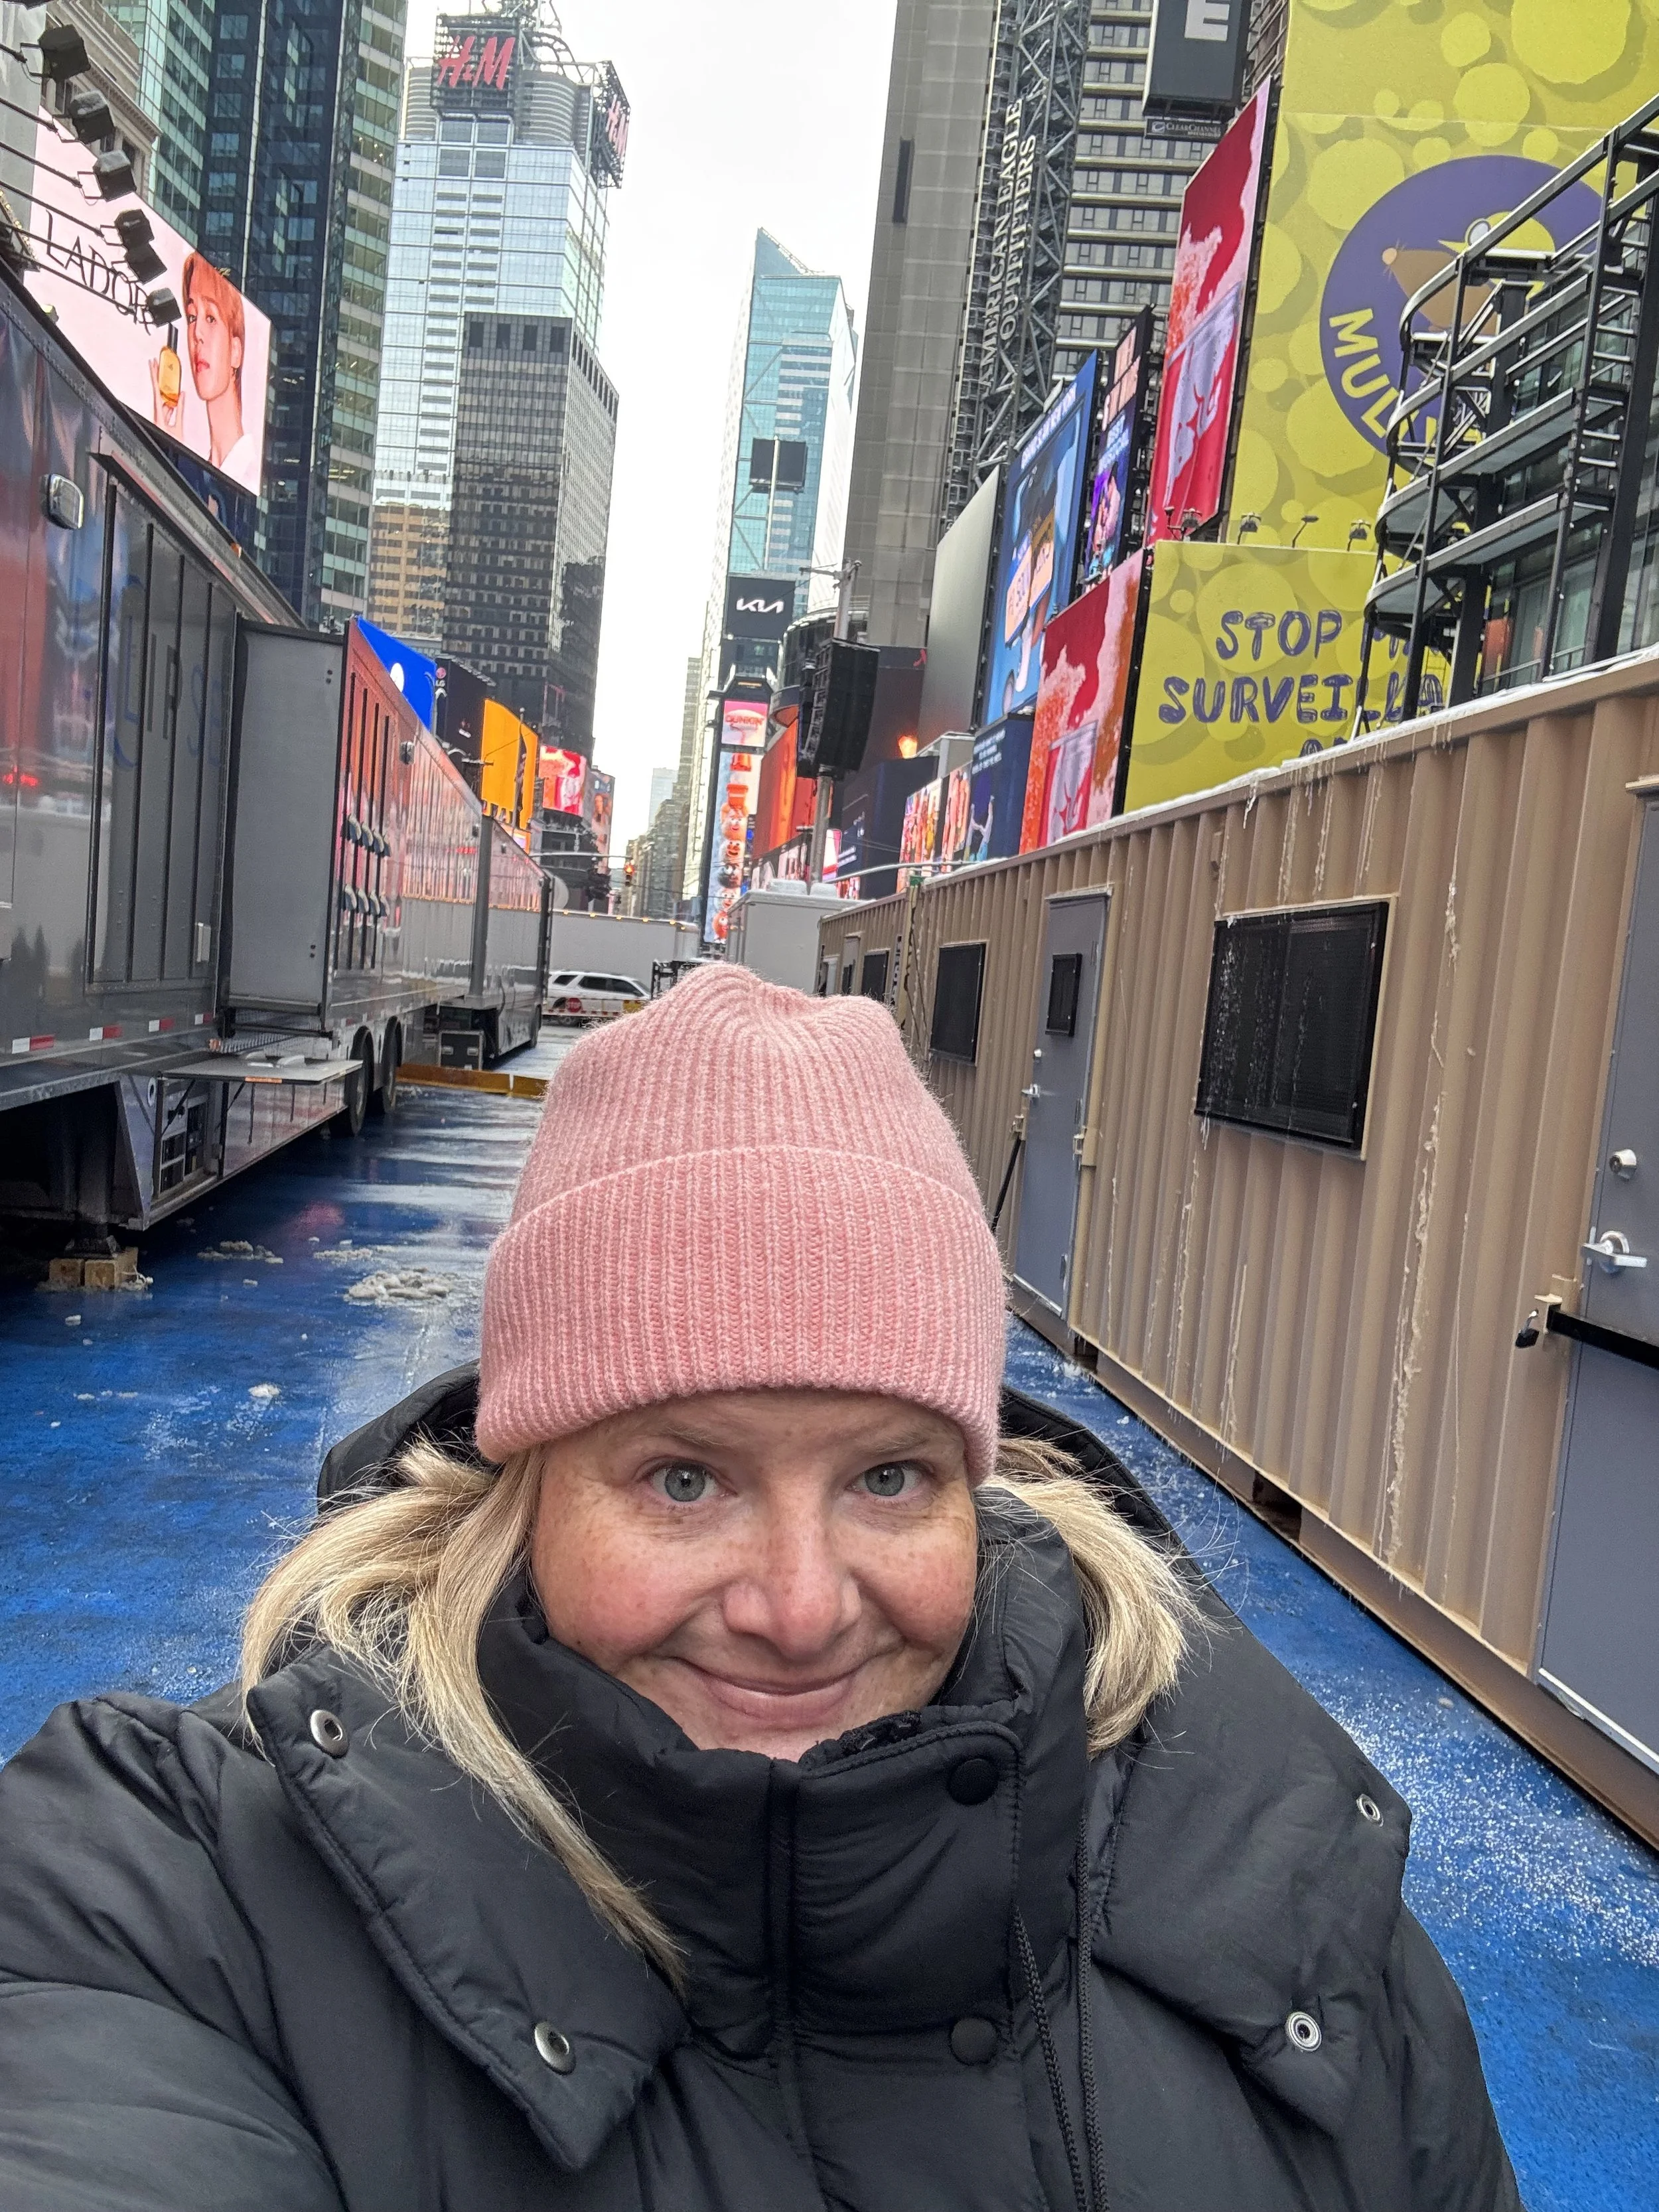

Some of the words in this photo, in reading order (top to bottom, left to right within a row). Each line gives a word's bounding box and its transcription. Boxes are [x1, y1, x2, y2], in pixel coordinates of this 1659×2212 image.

[436, 35, 516, 90] H&M
[978, 212, 1012, 388] AMERICAN
[996, 99, 1023, 206] EAGLE
[999, 135, 1037, 340] OUTFITTERS
[1216, 610, 1342, 661] STOP
